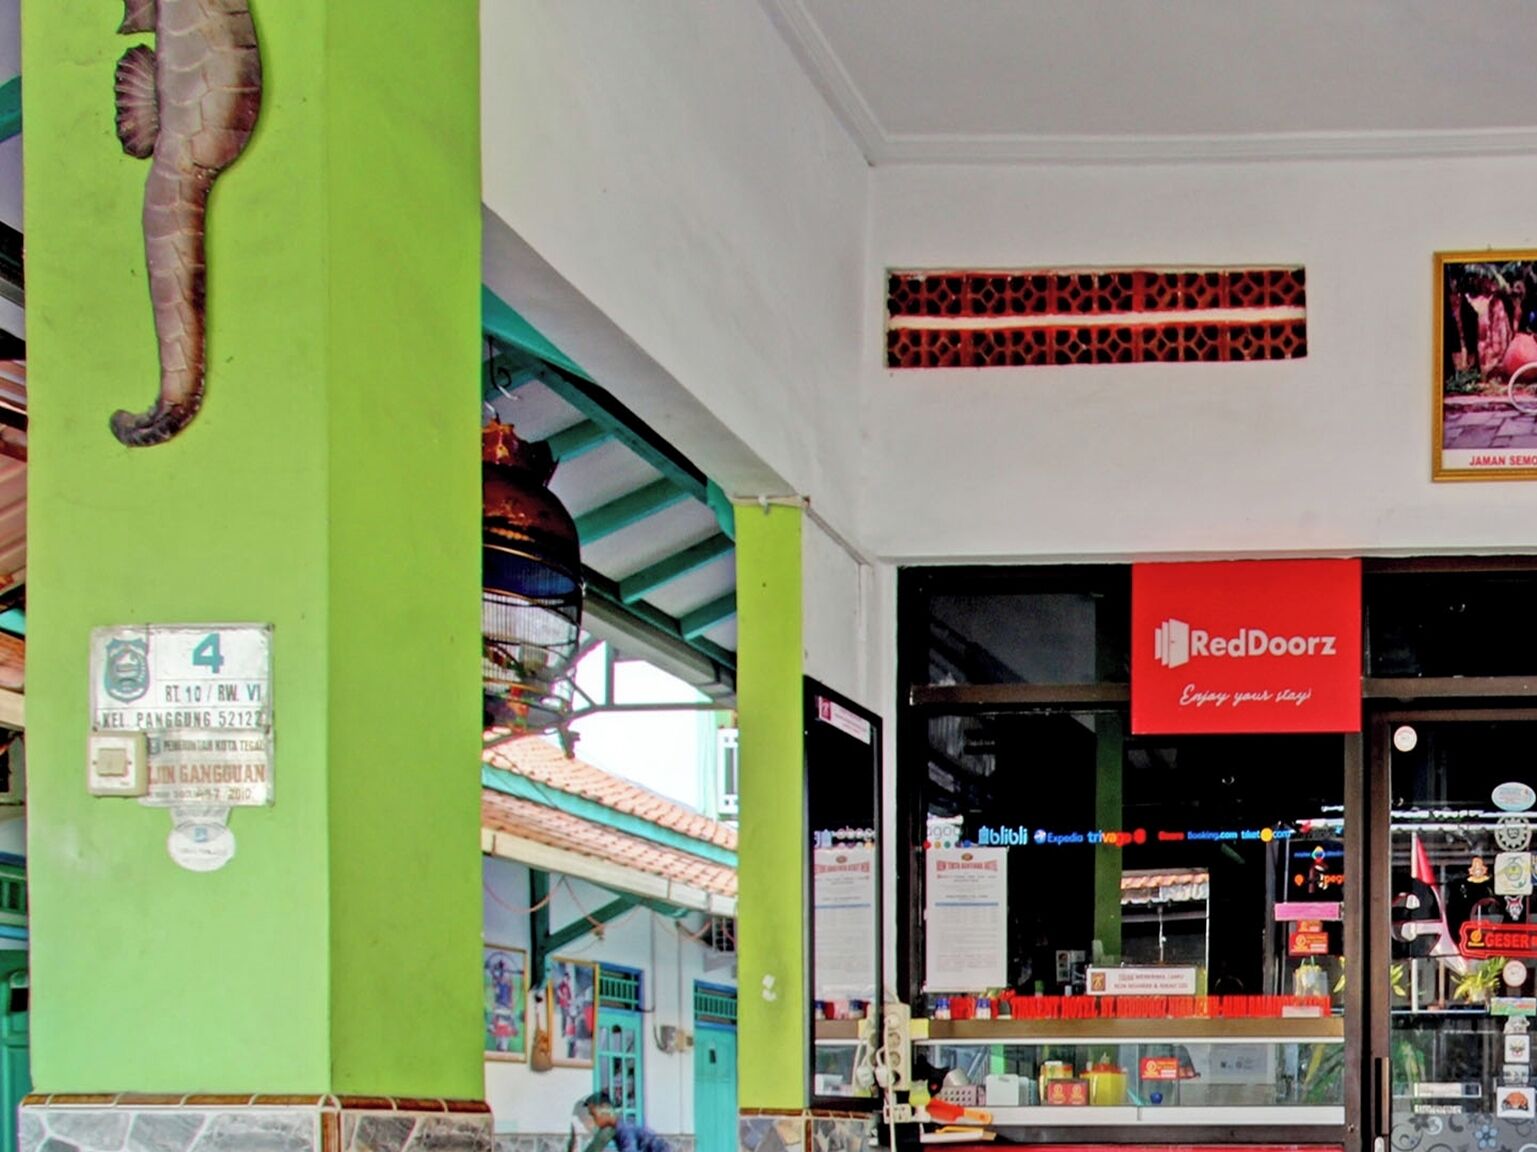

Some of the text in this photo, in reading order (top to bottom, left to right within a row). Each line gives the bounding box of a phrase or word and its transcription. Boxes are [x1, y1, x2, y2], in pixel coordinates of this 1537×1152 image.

[1469, 455, 1506, 467] JAMAN
[1191, 628, 1337, 657] RedDoorz
[192, 632, 224, 674] 4
[247, 683, 262, 702] VI
[1179, 684, 1230, 707] Enjoy
[1233, 691, 1273, 707] your
[136, 711, 211, 728] PANGGUNG
[179, 763, 266, 784] GANGGUAN
[988, 825, 1028, 846] blibli
[1046, 832, 1084, 845] Expedia
[1086, 830, 1133, 847] trivago
[1187, 830, 1238, 842] Booking.com
[1485, 932, 1530, 949] GESER
